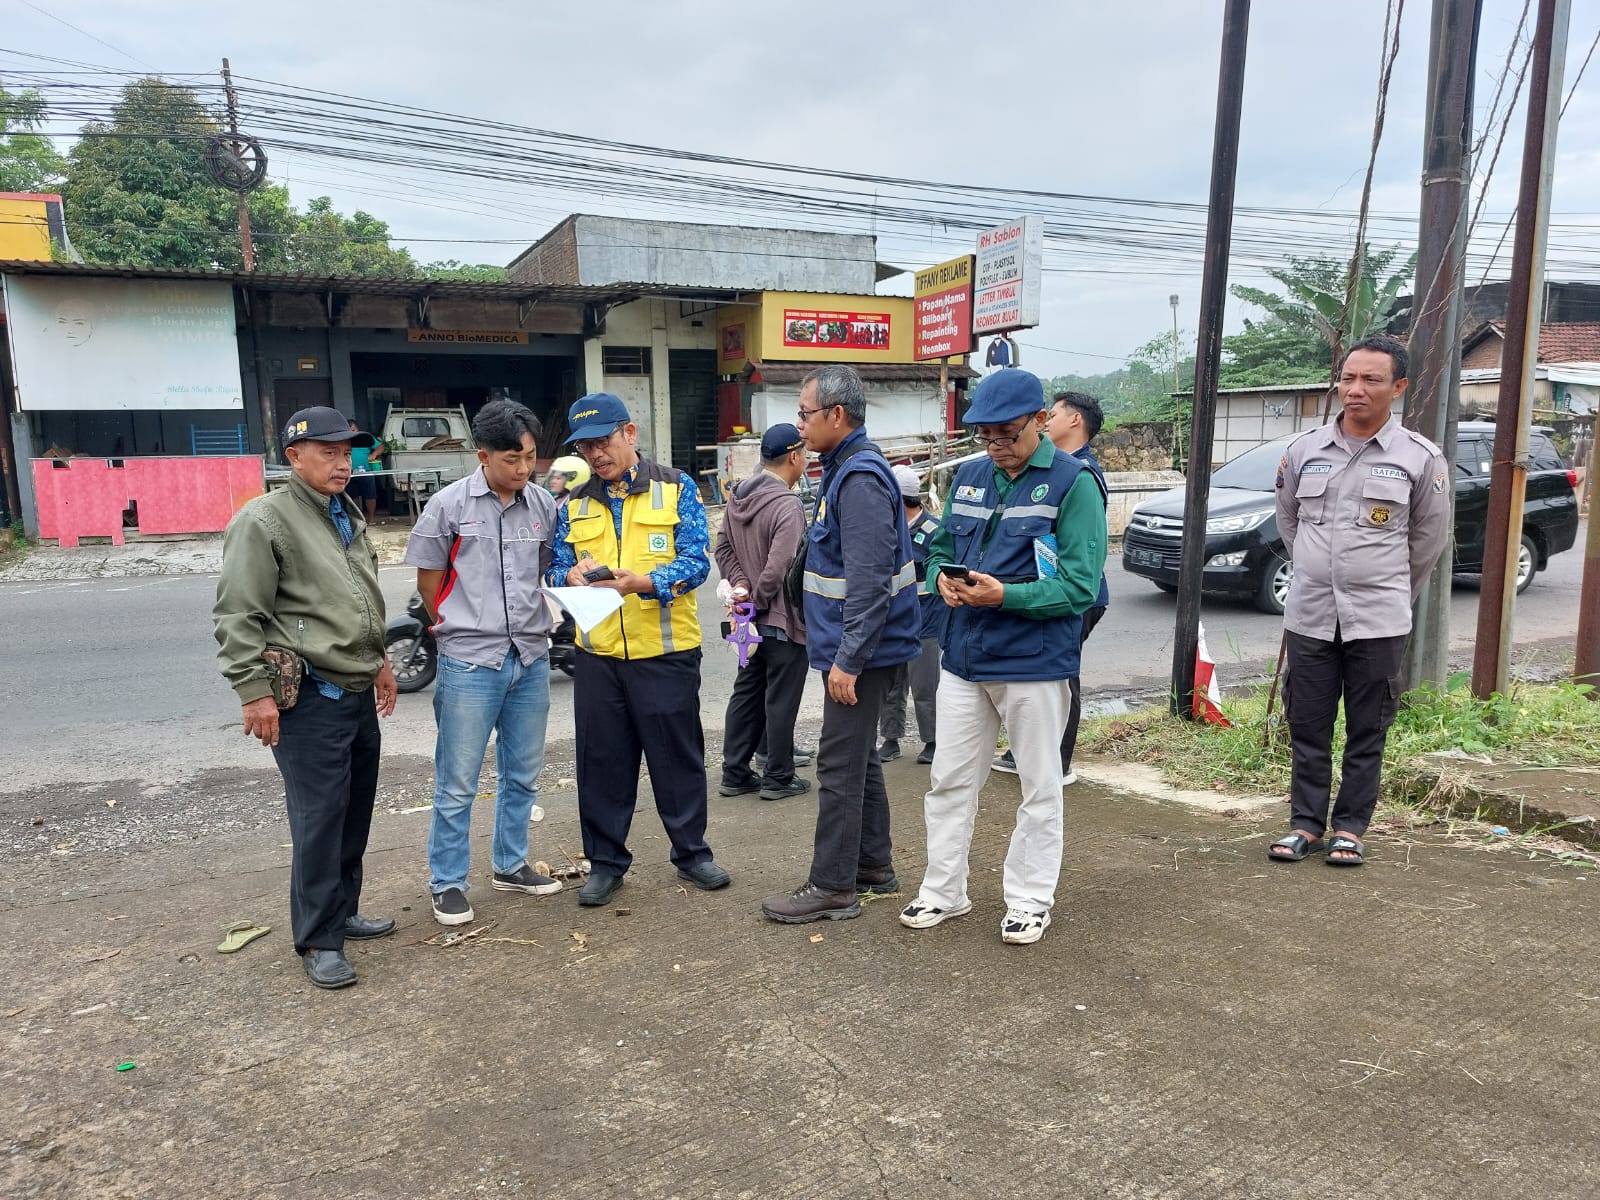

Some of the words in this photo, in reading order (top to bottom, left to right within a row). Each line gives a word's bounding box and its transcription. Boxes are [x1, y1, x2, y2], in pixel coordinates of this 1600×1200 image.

[980, 234, 991, 248] RH
[993, 226, 1021, 244] Sablon
[916, 270, 939, 291] TIFFANY
[940, 261, 968, 284] REKLAME
[922, 298, 943, 312] Papan
[944, 292, 966, 306] Nama
[979, 291, 995, 304] LETTER
[922, 309, 953, 326] Billboard
[976, 313, 1001, 328] NEONBOX
[1002, 309, 1019, 323] BULAT
[418, 334, 455, 342] ANNO
[457, 334, 519, 343] BioMEDICA
[921, 325, 958, 341] Repainting
[921, 342, 951, 355] Neonbox
[1373, 468, 1407, 479] SATPAM
